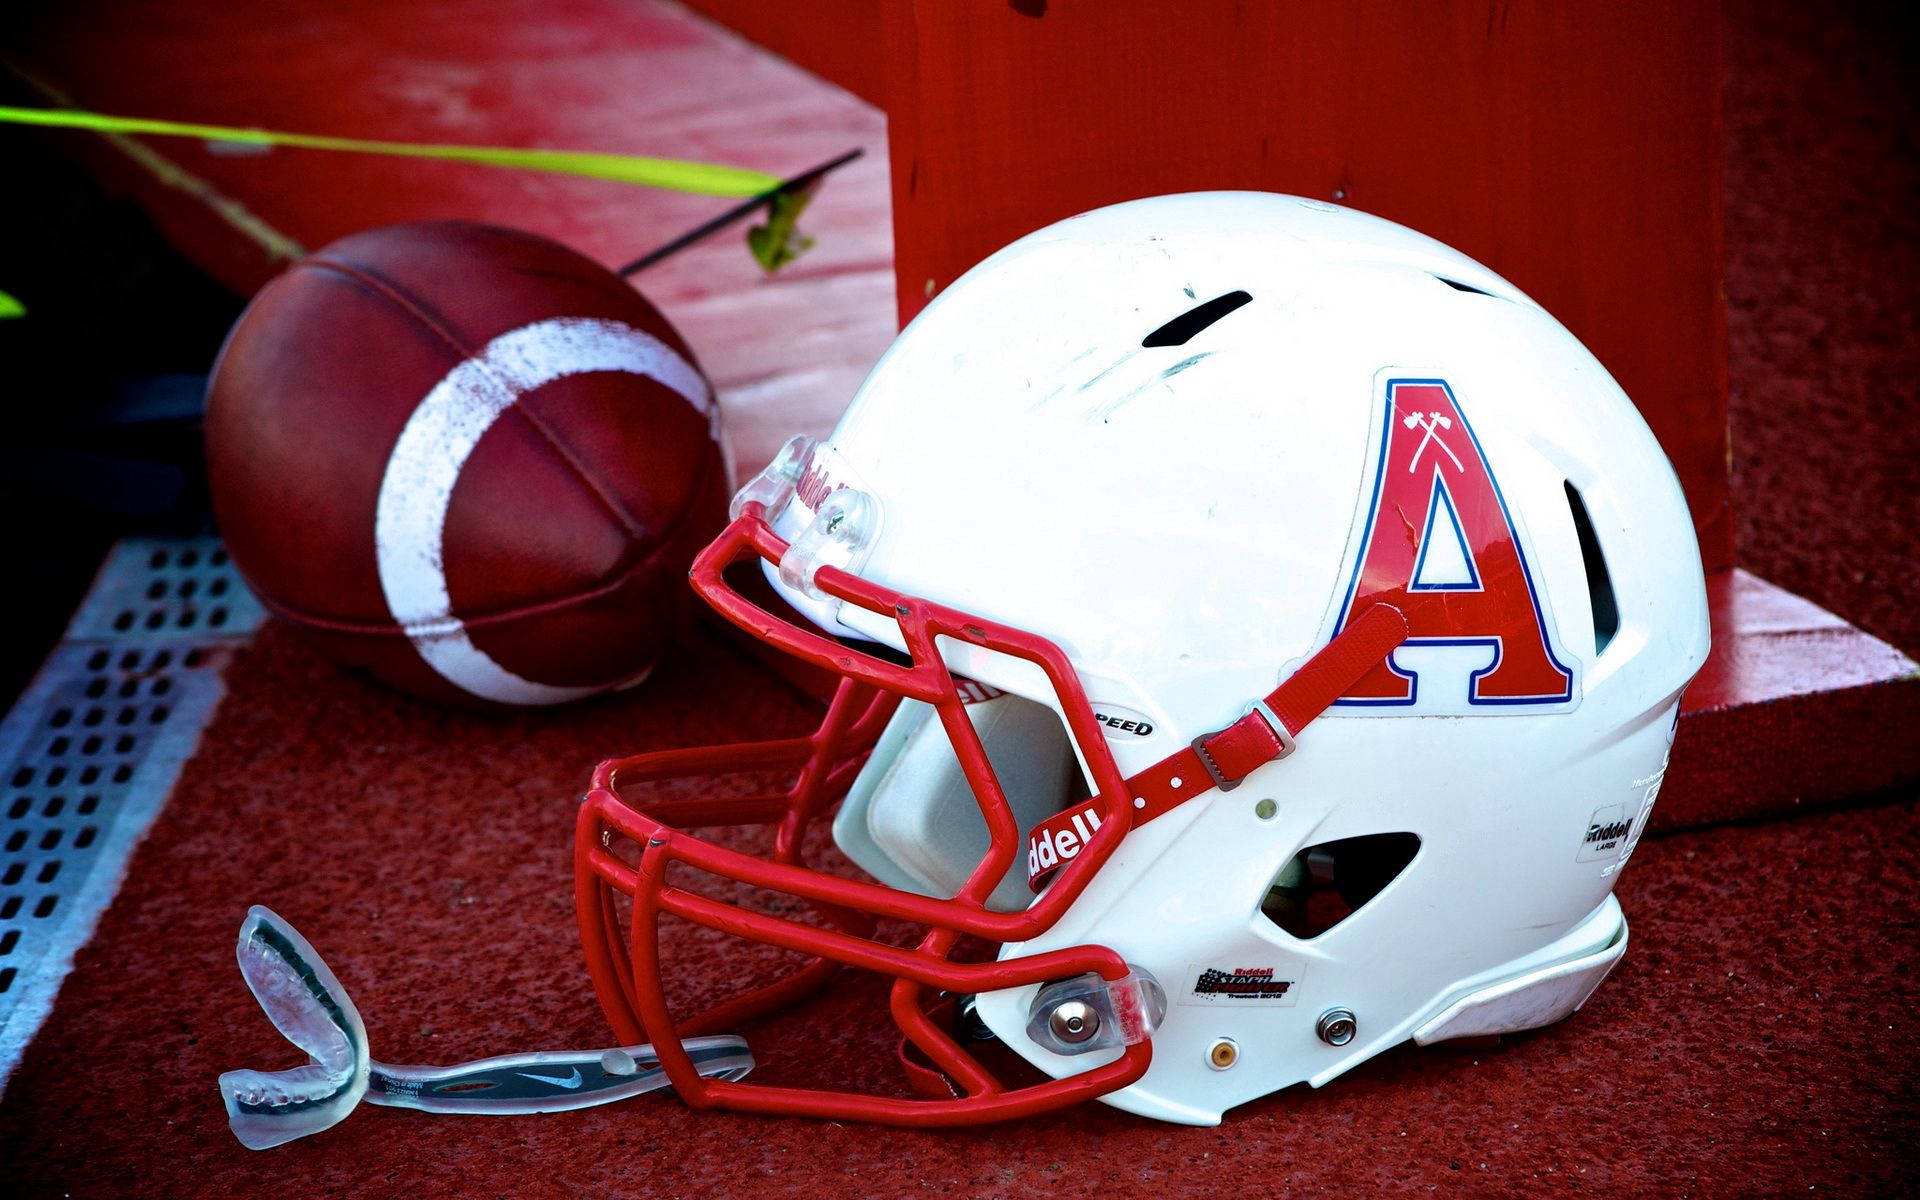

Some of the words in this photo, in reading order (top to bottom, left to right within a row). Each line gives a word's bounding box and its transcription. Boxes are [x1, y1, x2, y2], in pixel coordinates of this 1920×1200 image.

[1325, 378, 1573, 706] A
[1587, 818, 1633, 842] Riddell
[1220, 976, 1271, 984] STAPH
[1234, 968, 1273, 976] Riddell
